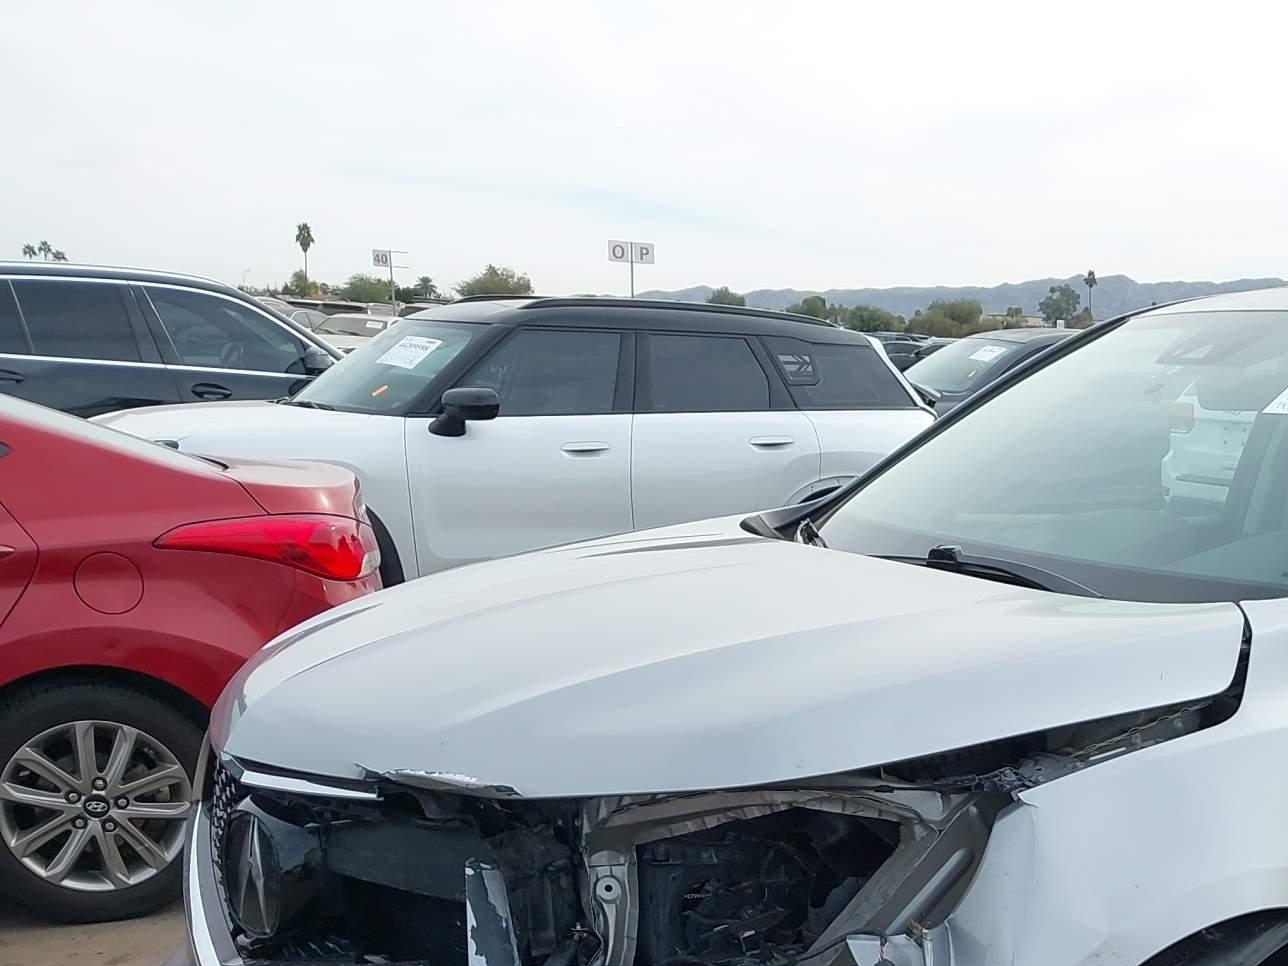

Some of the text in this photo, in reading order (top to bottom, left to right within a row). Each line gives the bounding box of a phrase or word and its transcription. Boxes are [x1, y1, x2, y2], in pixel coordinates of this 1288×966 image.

[374, 253, 388, 265] 40
[612, 244, 649, 261] O P
